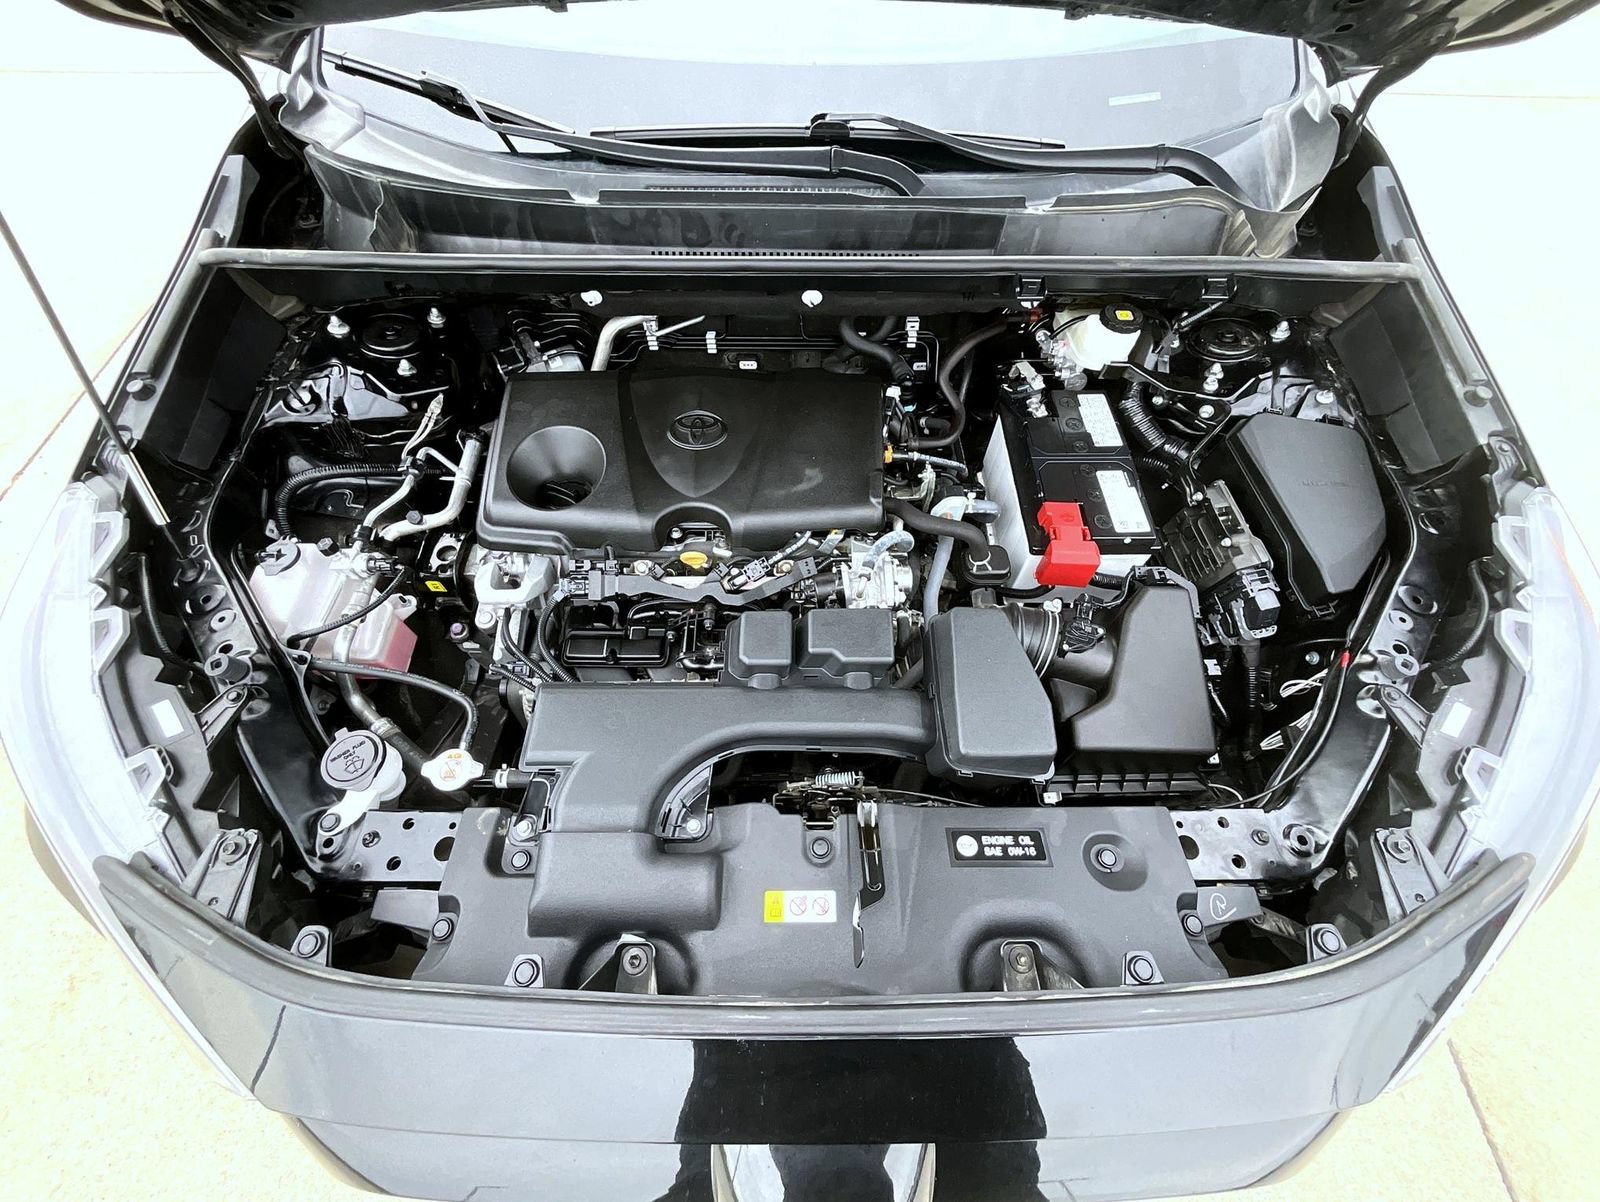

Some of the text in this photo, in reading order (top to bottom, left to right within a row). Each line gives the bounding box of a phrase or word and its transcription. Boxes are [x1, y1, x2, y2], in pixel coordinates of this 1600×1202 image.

[343, 750, 356, 760] ONLY
[981, 835, 1034, 845] ENGINE OIL
[983, 846, 1003, 856] SAE
